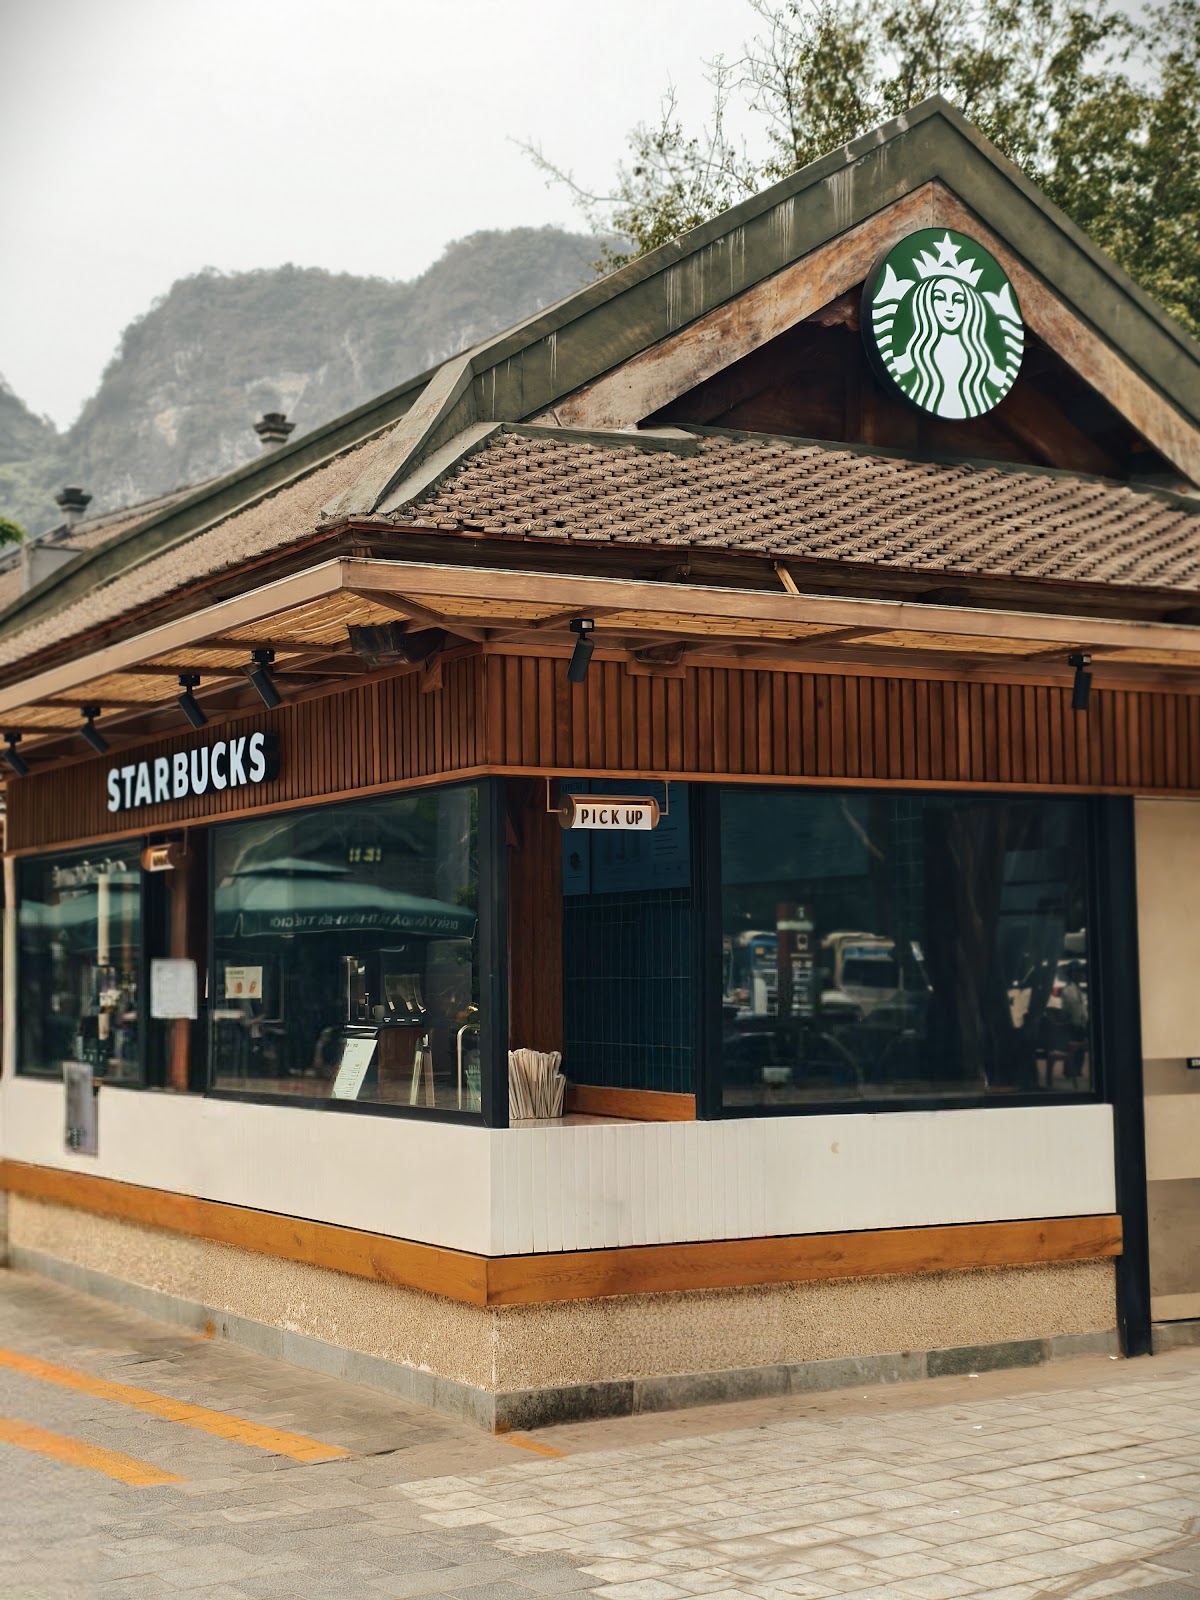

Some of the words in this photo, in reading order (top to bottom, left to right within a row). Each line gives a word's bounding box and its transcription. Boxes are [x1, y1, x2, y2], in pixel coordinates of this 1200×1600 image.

[107, 732, 266, 812] STARBUCKS
[581, 809, 620, 825] PICK
[626, 810, 643, 825] UP
